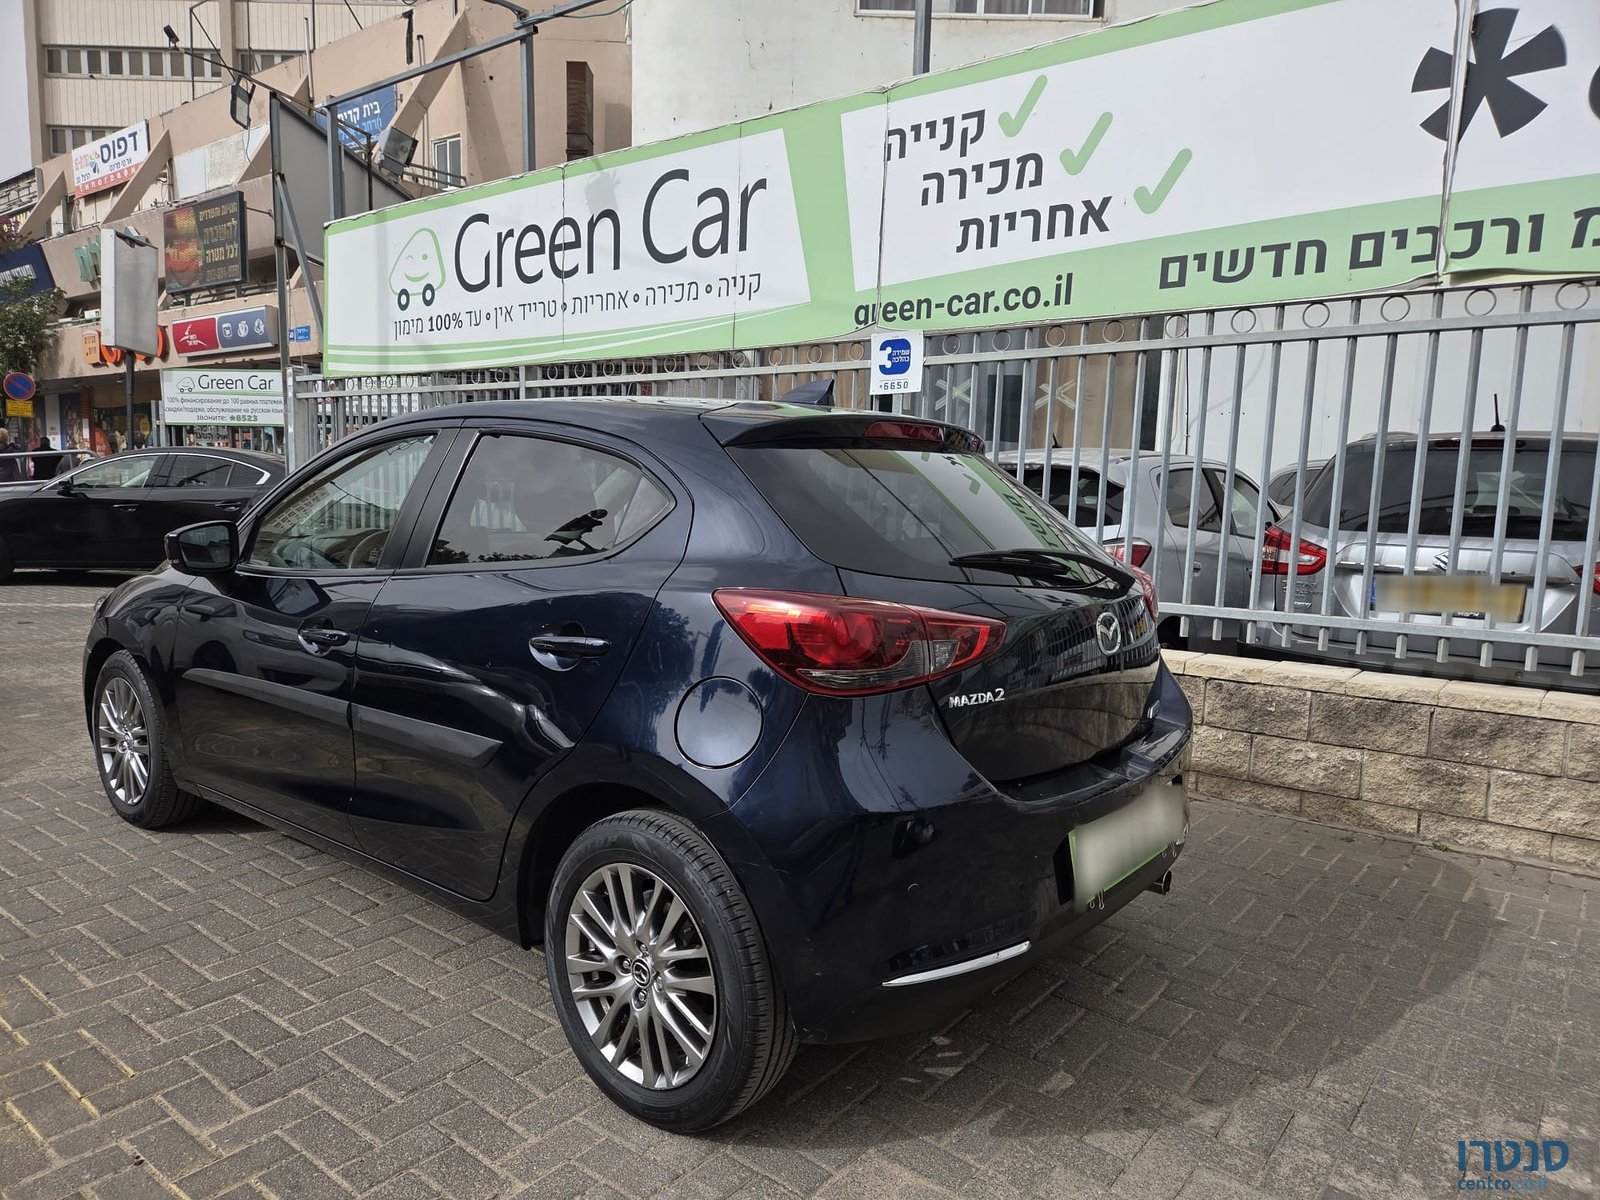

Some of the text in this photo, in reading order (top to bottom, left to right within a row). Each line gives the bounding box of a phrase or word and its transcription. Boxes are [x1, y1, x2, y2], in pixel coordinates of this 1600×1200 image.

[363, 101, 381, 118] בית
[886, 108, 986, 161] קנייה
[100, 131, 138, 164] דפוס
[79, 164, 139, 192] Типографи
[921, 152, 1044, 207] מכירה
[454, 168, 767, 293] Green Car
[955, 195, 1113, 253] אחריות
[1349, 213, 1545, 270] ורכבים
[1158, 239, 1328, 290] חדשים
[394, 273, 761, 341] קניה מכירה אחריות טרייד אין עד 100% מימון
[854, 273, 1074, 329] green-car.co.il
[198, 374, 274, 390] Green Car
[949, 688, 1005, 708] MAZDA2
